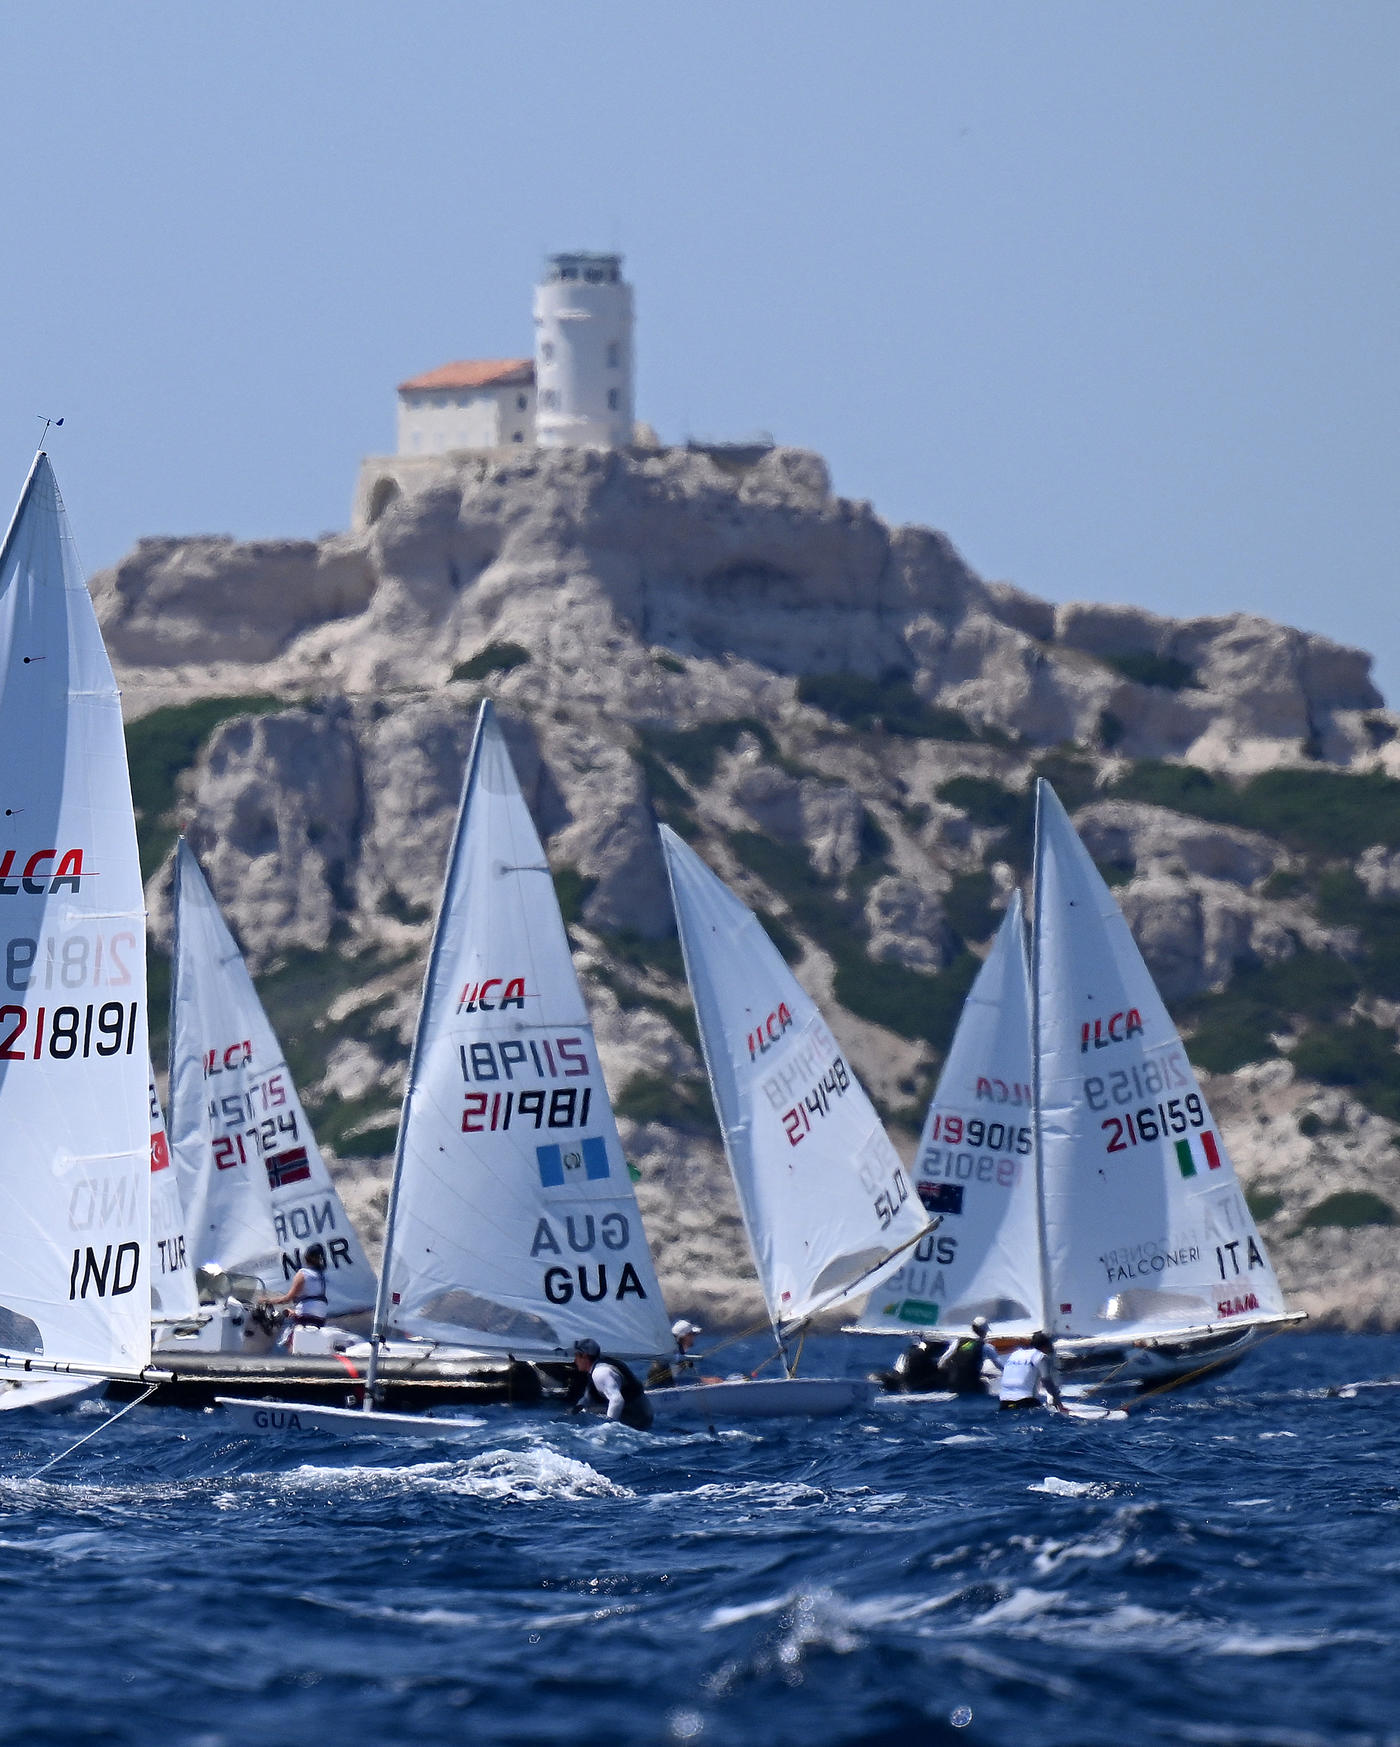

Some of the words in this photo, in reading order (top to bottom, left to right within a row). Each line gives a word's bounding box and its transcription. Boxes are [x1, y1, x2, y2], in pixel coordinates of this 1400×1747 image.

[456, 977, 526, 1015] ILCA
[747, 1002, 793, 1063] ILCA
[1081, 1008, 1145, 1054] ILCA
[203, 1040, 253, 1080] ILCA
[461, 1088, 592, 1133] 211981
[782, 1055, 851, 1147] 214148
[933, 1113, 1032, 1155] 199015
[1102, 1093, 1204, 1153] 216159
[69, 1241, 140, 1300] IND
[157, 1234, 187, 1275] TUR
[1107, 1246, 1200, 1284] FALCONERI
[1216, 1236, 1264, 1280] ITA
[544, 1262, 648, 1305] GUA
[253, 1410, 302, 1430] GUA
